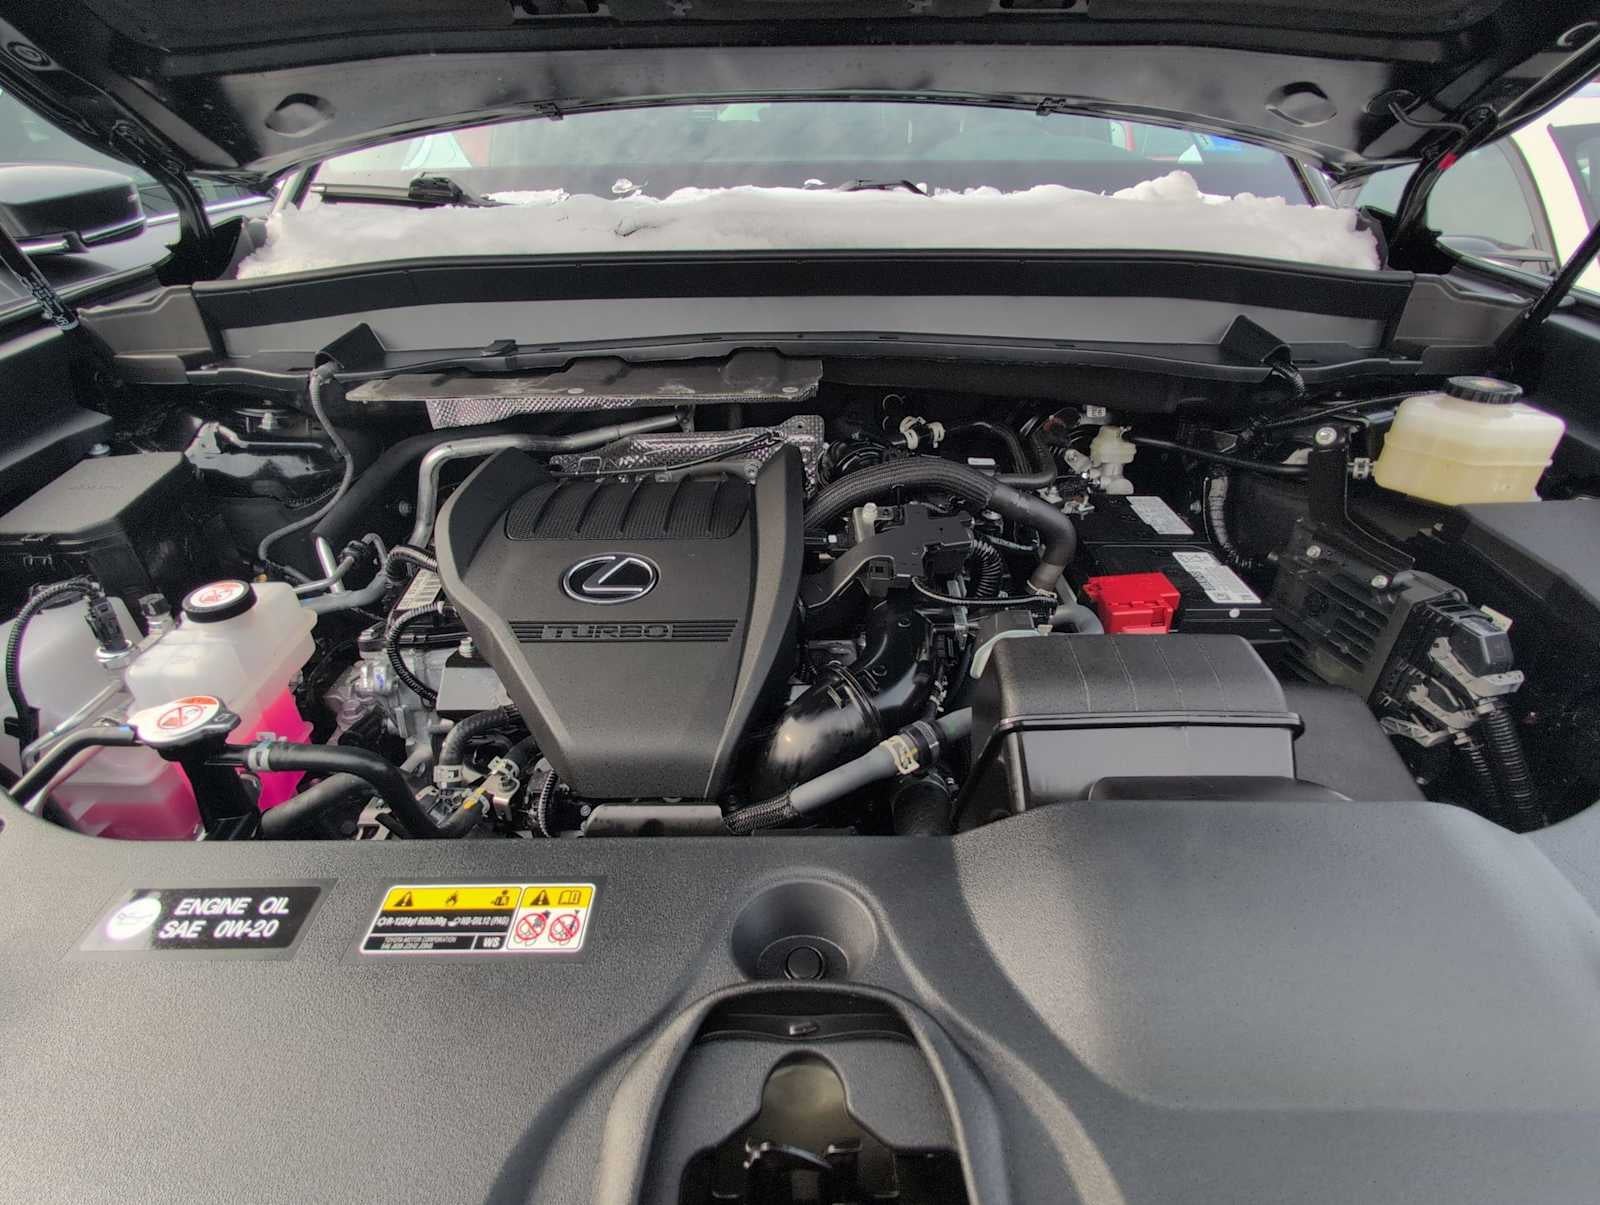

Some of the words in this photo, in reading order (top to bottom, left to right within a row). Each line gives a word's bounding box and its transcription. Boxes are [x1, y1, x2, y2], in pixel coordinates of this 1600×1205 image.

[541, 623, 673, 640] TURBO
[173, 897, 252, 915] ENGINE
[258, 896, 290, 915] OIL
[158, 920, 207, 939] SAE
[213, 919, 280, 938] 0W-20
